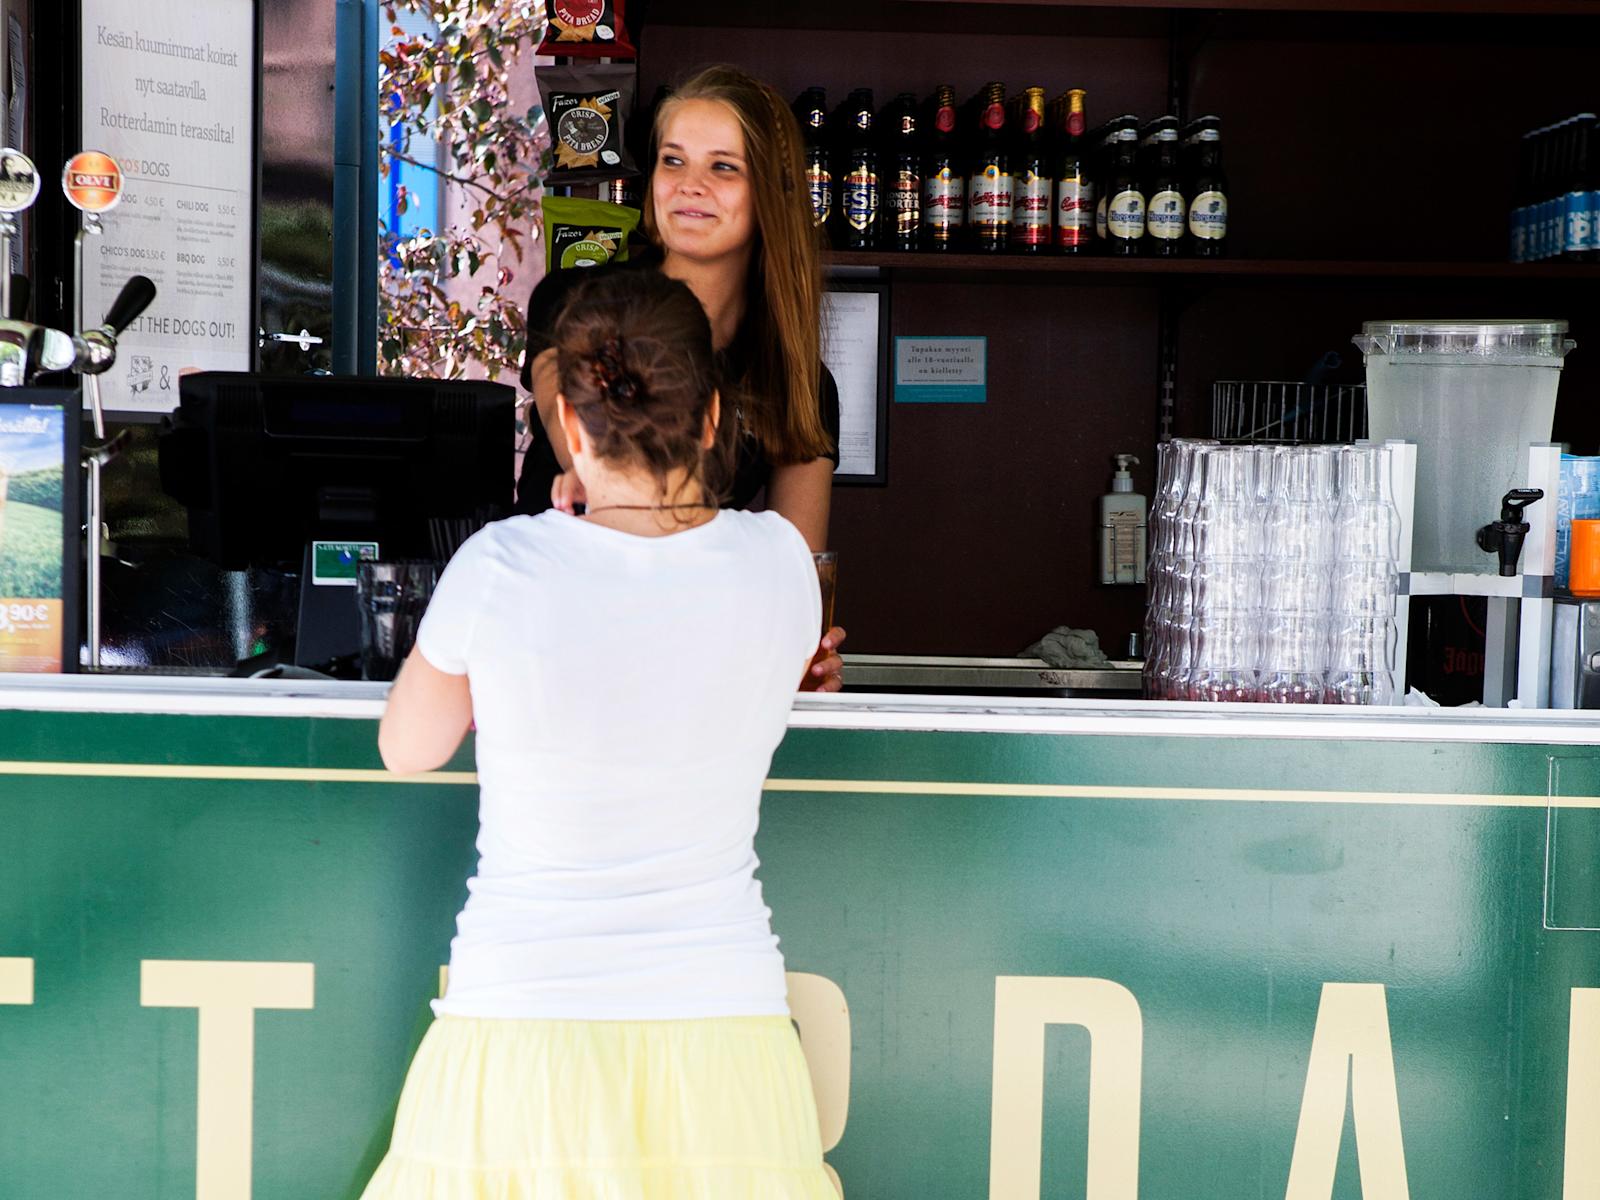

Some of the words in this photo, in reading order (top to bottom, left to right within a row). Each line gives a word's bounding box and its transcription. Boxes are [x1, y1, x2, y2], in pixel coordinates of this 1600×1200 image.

[558, 8, 575, 25] PITA
[576, 8, 600, 26] BREAD
[97, 25, 133, 49] Kesän
[135, 31, 205, 61] kuumimmat
[207, 43, 238, 67] koirat
[135, 76, 154, 98] nyt
[157, 78, 207, 101] saatavilla
[571, 110, 596, 120] CRISP
[100, 107, 177, 136] Rotterdamin
[181, 120, 235, 144] terassilta!
[563, 134, 580, 150] PITA
[580, 134, 605, 151] BREAD
[141, 160, 170, 178] DOGS
[121, 192, 137, 204] DOG
[842, 188, 880, 209] ESB
[886, 192, 920, 200] LONDON
[176, 199, 194, 211] CHILI
[194, 202, 209, 213] DOG
[129, 247, 146, 259] DOG
[176, 253, 191, 265] BBQ
[192, 254, 206, 265] DOG
[147, 316, 170, 334] THE
[173, 319, 206, 337] DOGS
[209, 322, 235, 339] OUT!
